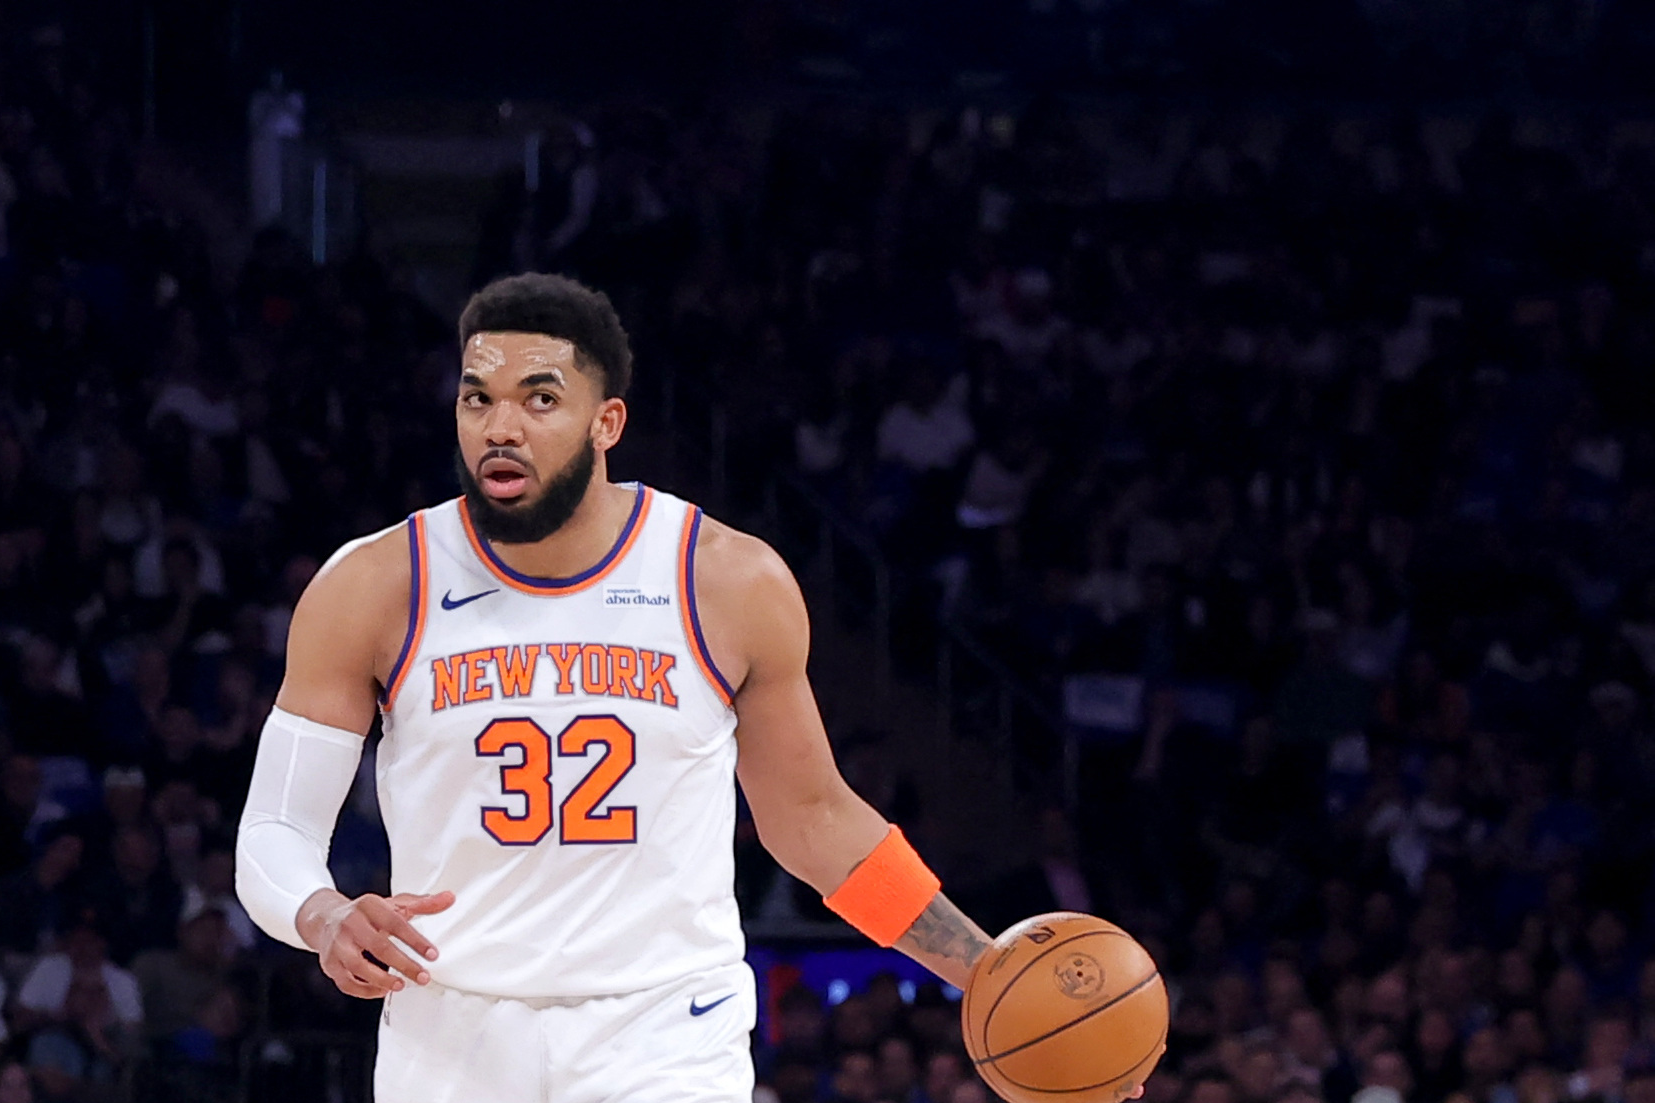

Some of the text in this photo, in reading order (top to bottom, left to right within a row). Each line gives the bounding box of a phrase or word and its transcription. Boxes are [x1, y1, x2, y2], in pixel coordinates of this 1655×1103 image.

[605, 594, 671, 606] abu dhabi
[431, 642, 680, 713] NEW YORK
[474, 713, 638, 846] 32
